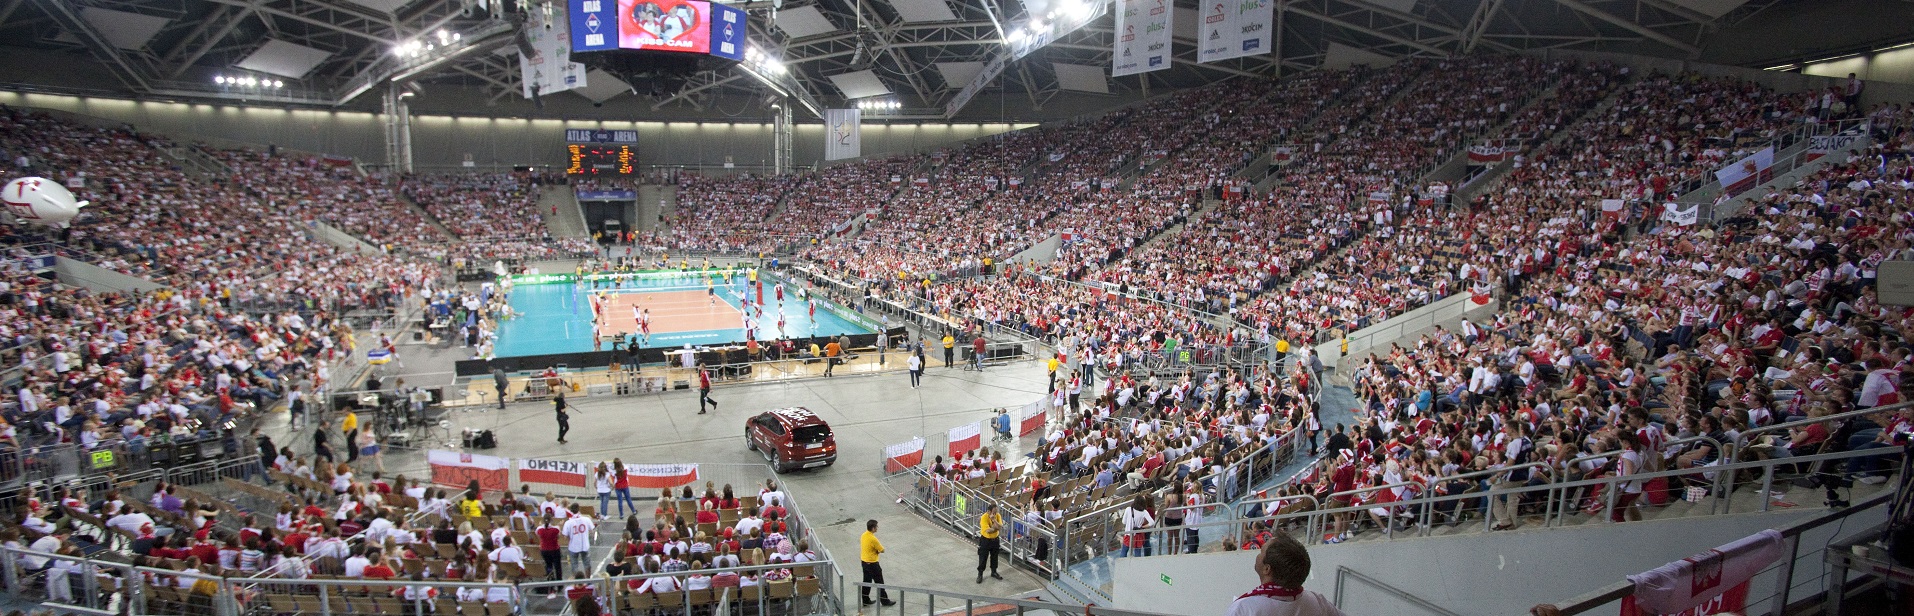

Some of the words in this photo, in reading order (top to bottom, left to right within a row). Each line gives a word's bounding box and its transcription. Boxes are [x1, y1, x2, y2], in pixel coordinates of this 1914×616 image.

[583, 1, 601, 13] ATLAS
[723, 10, 737, 24] ATLAS
[585, 34, 605, 46] ARENA
[636, 37, 662, 46] KISS
[665, 39, 693, 48] CAM
[720, 41, 735, 55] ARENA
[566, 129, 591, 142] ATLAS
[613, 130, 638, 142] ARENA
[1180, 351, 1190, 360] PG
[91, 450, 113, 464] PB
[956, 494, 966, 511] PH
[573, 523, 586, 535] 10
